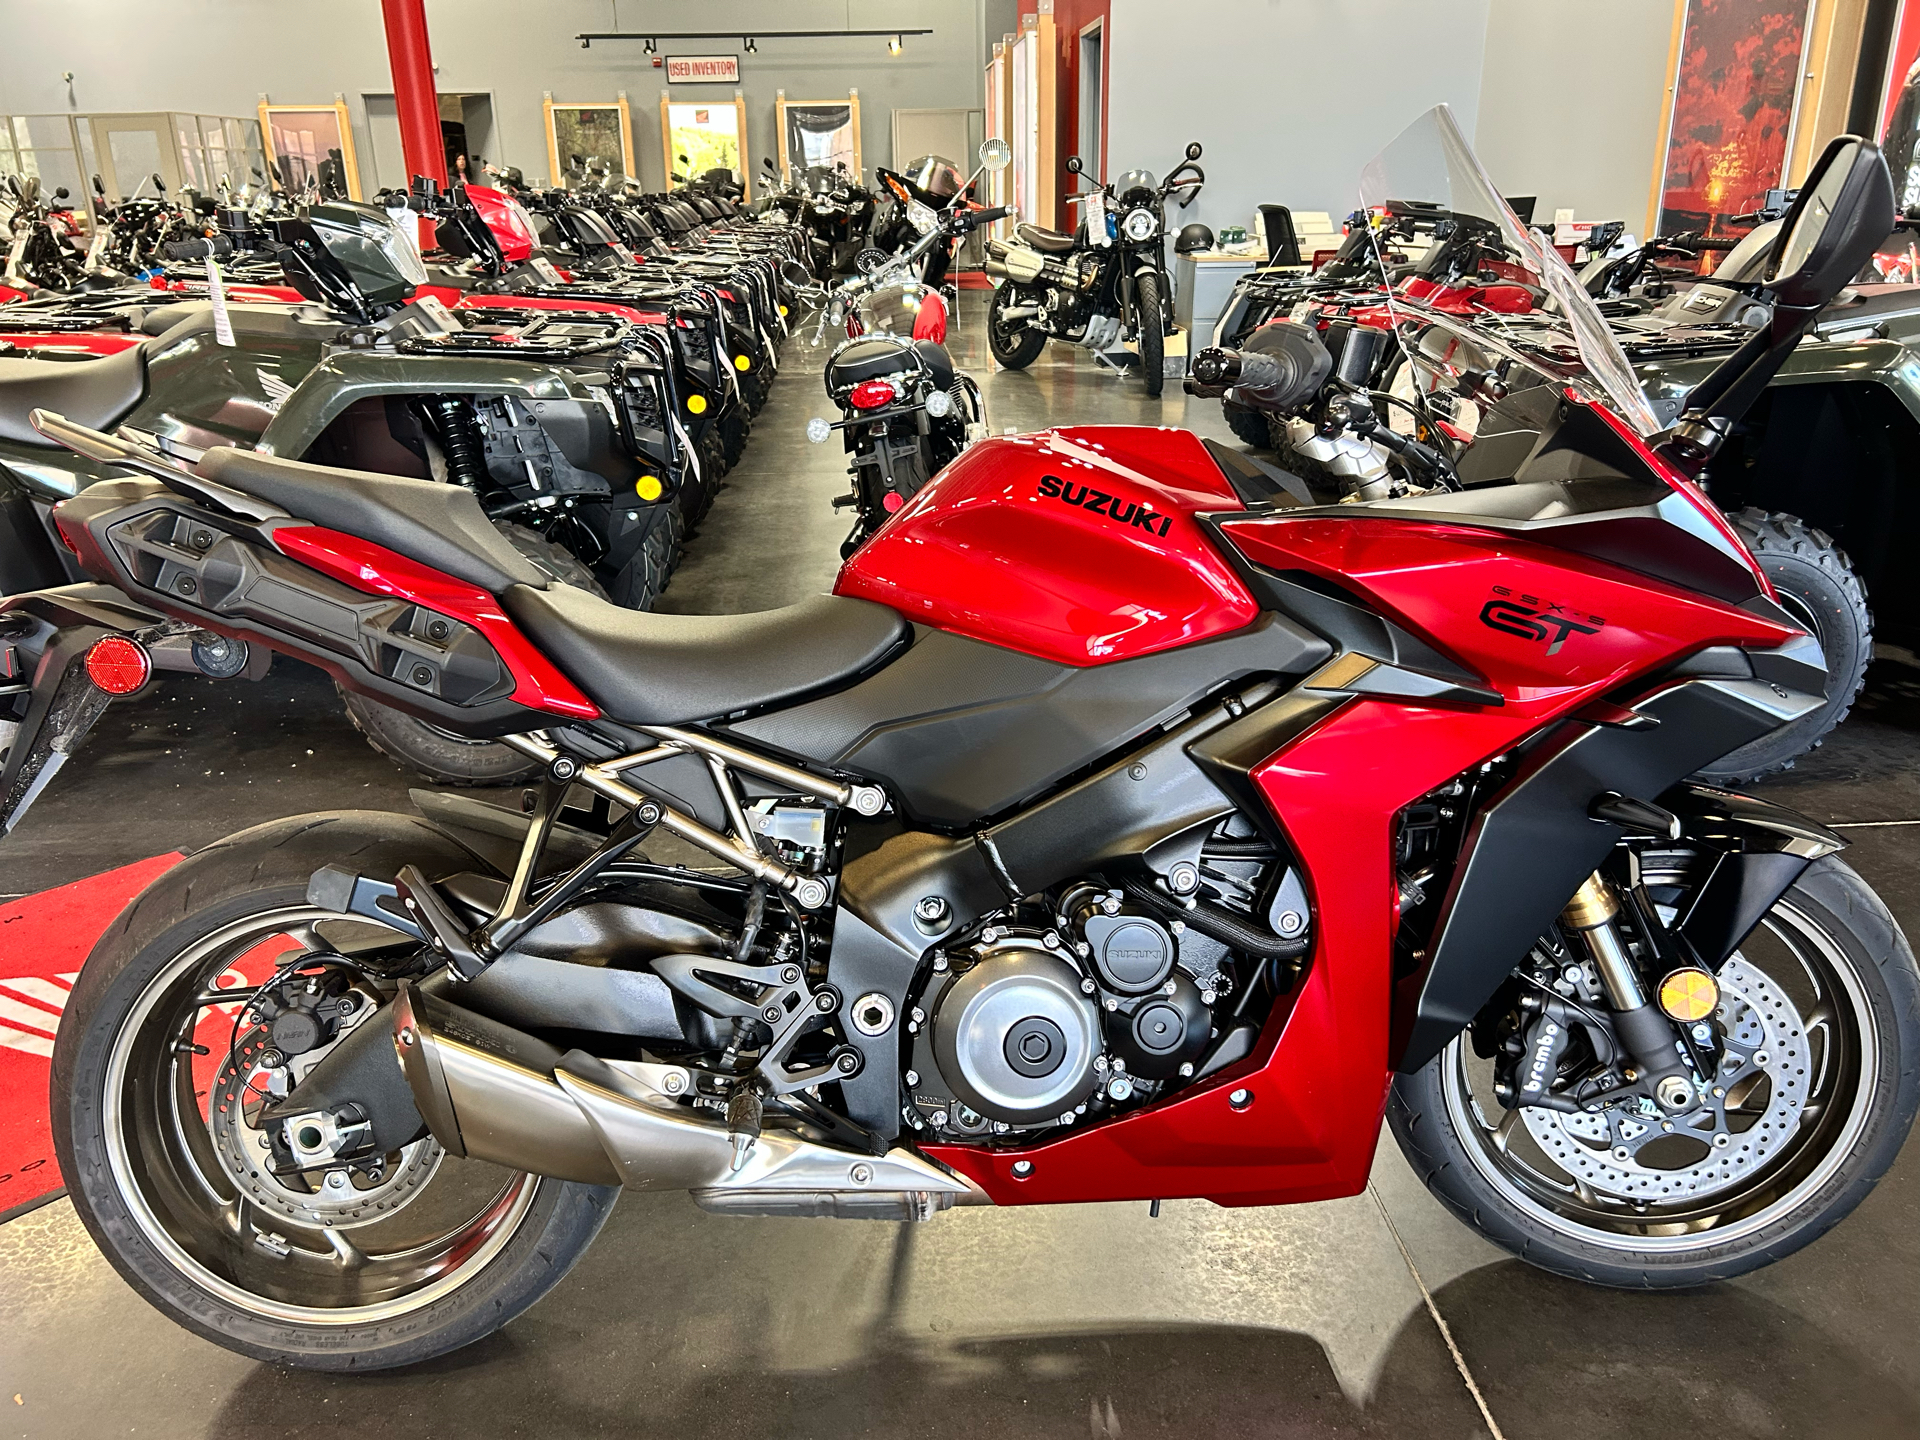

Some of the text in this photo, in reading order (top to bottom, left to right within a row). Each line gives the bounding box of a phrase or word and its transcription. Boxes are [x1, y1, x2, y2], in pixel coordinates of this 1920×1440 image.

[669, 61, 736, 76] USED INVENTORY
[1037, 474, 1173, 538] SUZUKI
[1491, 585, 1607, 626] GSX-S
[1108, 949, 1162, 960] SUZUKI
[1523, 1024, 1558, 1092] brembo
